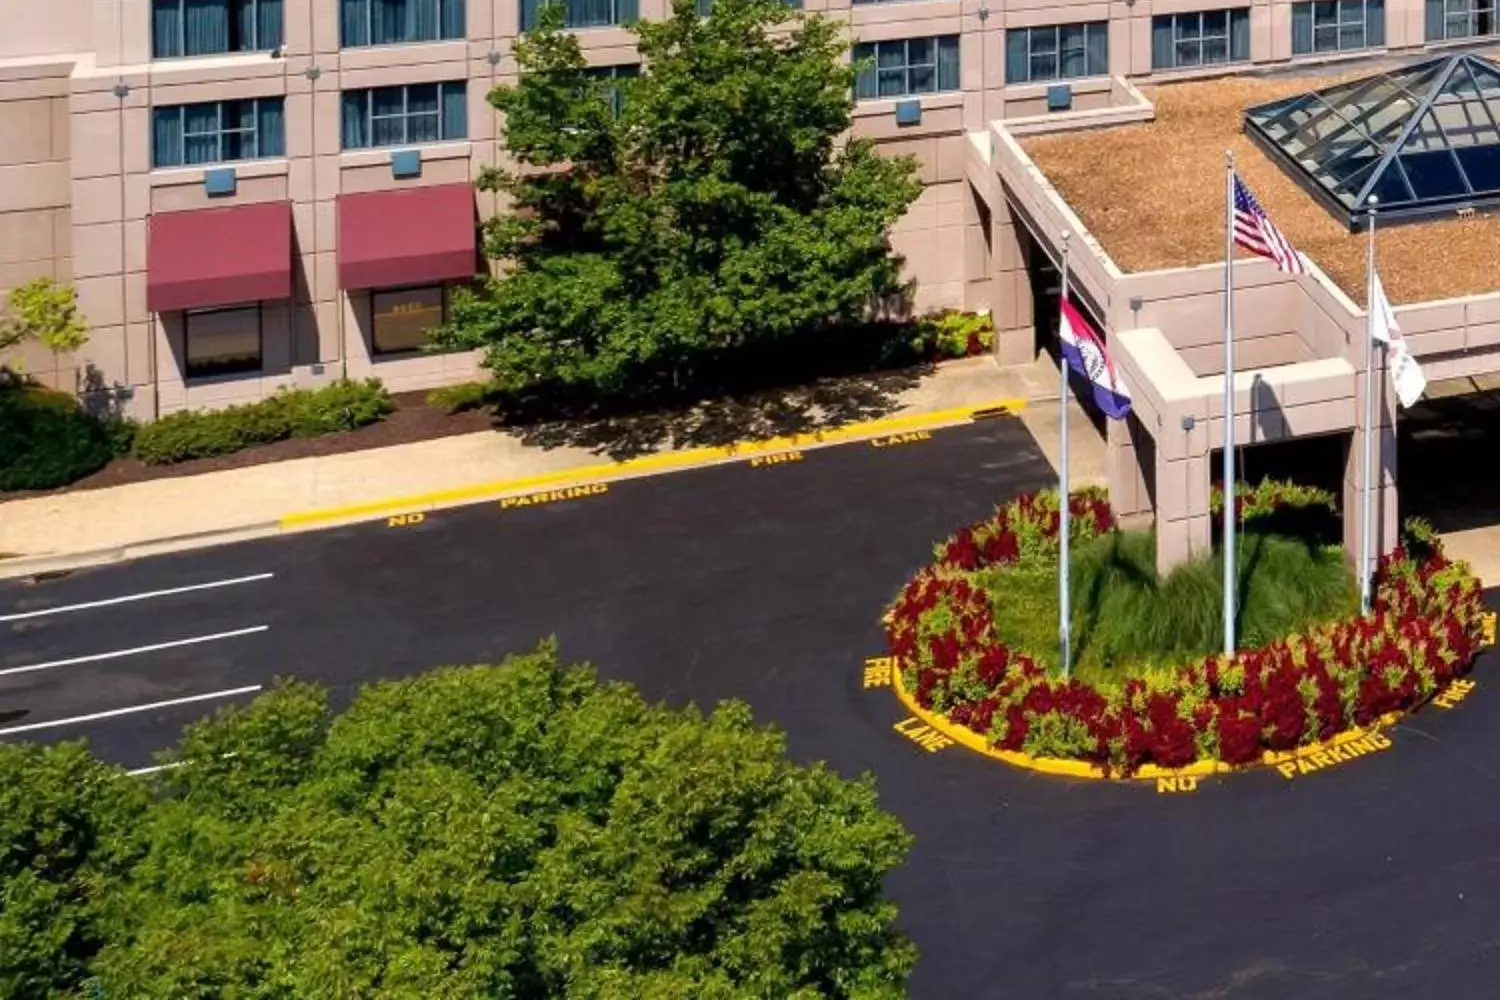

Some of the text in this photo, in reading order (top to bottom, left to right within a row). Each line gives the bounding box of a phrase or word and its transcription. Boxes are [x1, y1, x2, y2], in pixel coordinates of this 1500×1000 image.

[501, 483, 609, 509] PARKING
[870, 430, 932, 448] LANE
[863, 656, 892, 689] FIRE
[893, 716, 955, 752] LANE
[1277, 732, 1393, 780] PARKING
